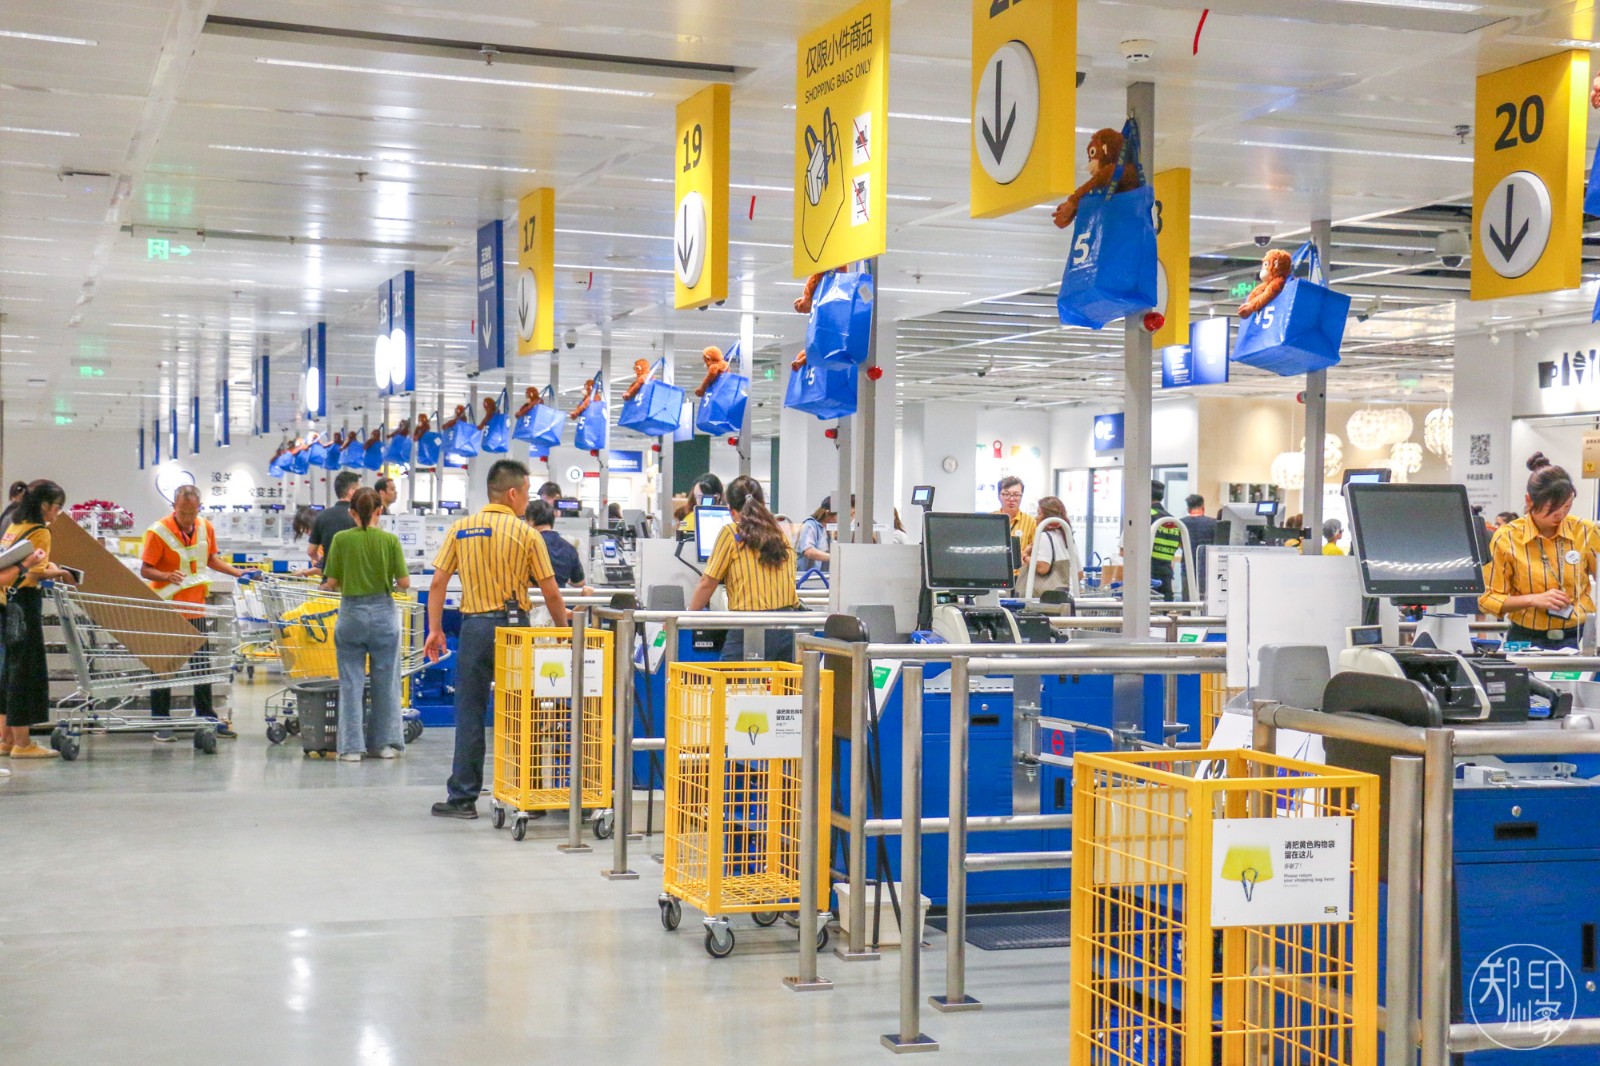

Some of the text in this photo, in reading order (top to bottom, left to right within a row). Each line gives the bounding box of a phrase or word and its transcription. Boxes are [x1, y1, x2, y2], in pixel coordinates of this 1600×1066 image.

[805, 13, 873, 79] 仅限小件商品
[805, 57, 872, 104] SHOPPING BAGS ONLY
[1494, 94, 1545, 151] 20
[683, 123, 702, 173] 19
[523, 216, 536, 253] 17
[1073, 231, 1091, 265] 5
[1284, 840, 1335, 849] 请把黄色购物袋
[1284, 850, 1314, 859] 留在这儿
